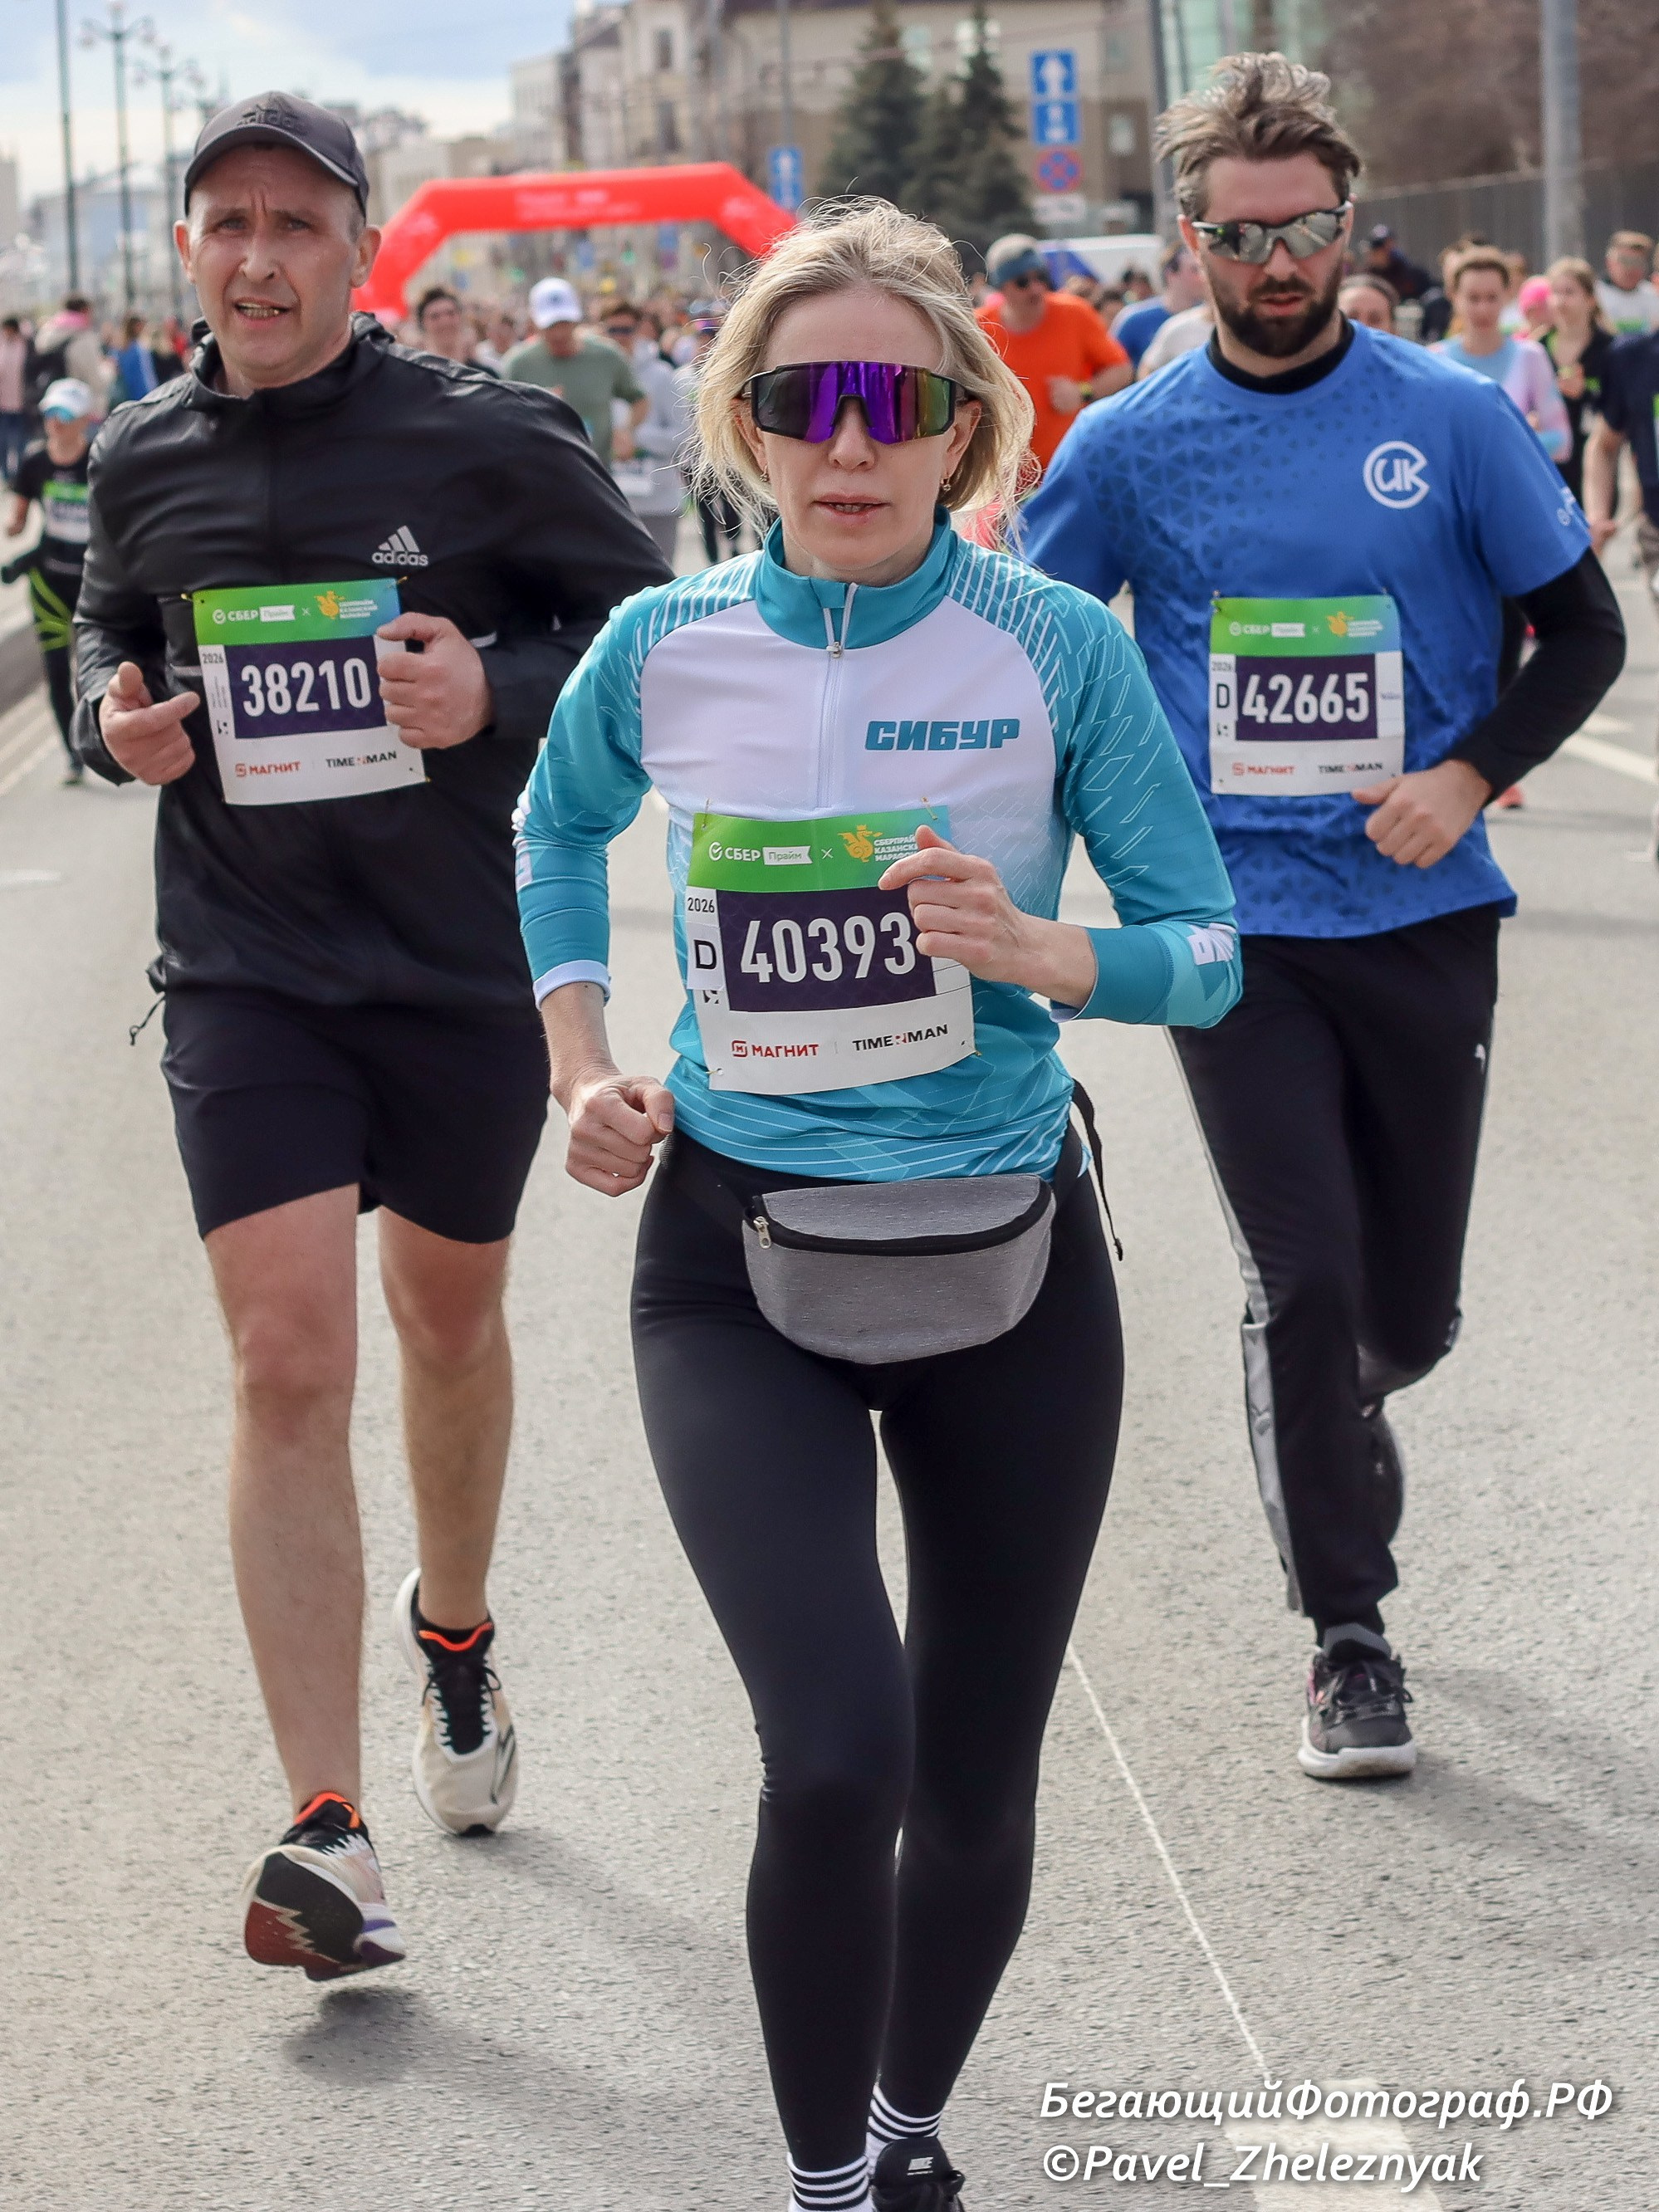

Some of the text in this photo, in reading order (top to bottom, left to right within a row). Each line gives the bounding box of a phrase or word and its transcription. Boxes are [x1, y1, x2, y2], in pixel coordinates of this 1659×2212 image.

[371, 550, 429, 566] adidas
[202, 653, 224, 664] 2026
[241, 657, 372, 717] 38210
[1216, 683, 1230, 708] D
[1241, 672, 1370, 724] 42665
[864, 717, 1020, 751] СИБУР
[248, 761, 301, 776] МАГНИТ
[874, 834, 917, 847] СБЕРПРАЙ
[724, 846, 803, 862] СБЕР Прайм
[874, 843, 919, 855] КАЗАНСК
[874, 850, 918, 862] МАРАФО
[687, 897, 715, 913] 2026
[693, 939, 717, 970] D
[741, 912, 917, 984] 40393
[751, 1043, 820, 1059] МАГНИТ
